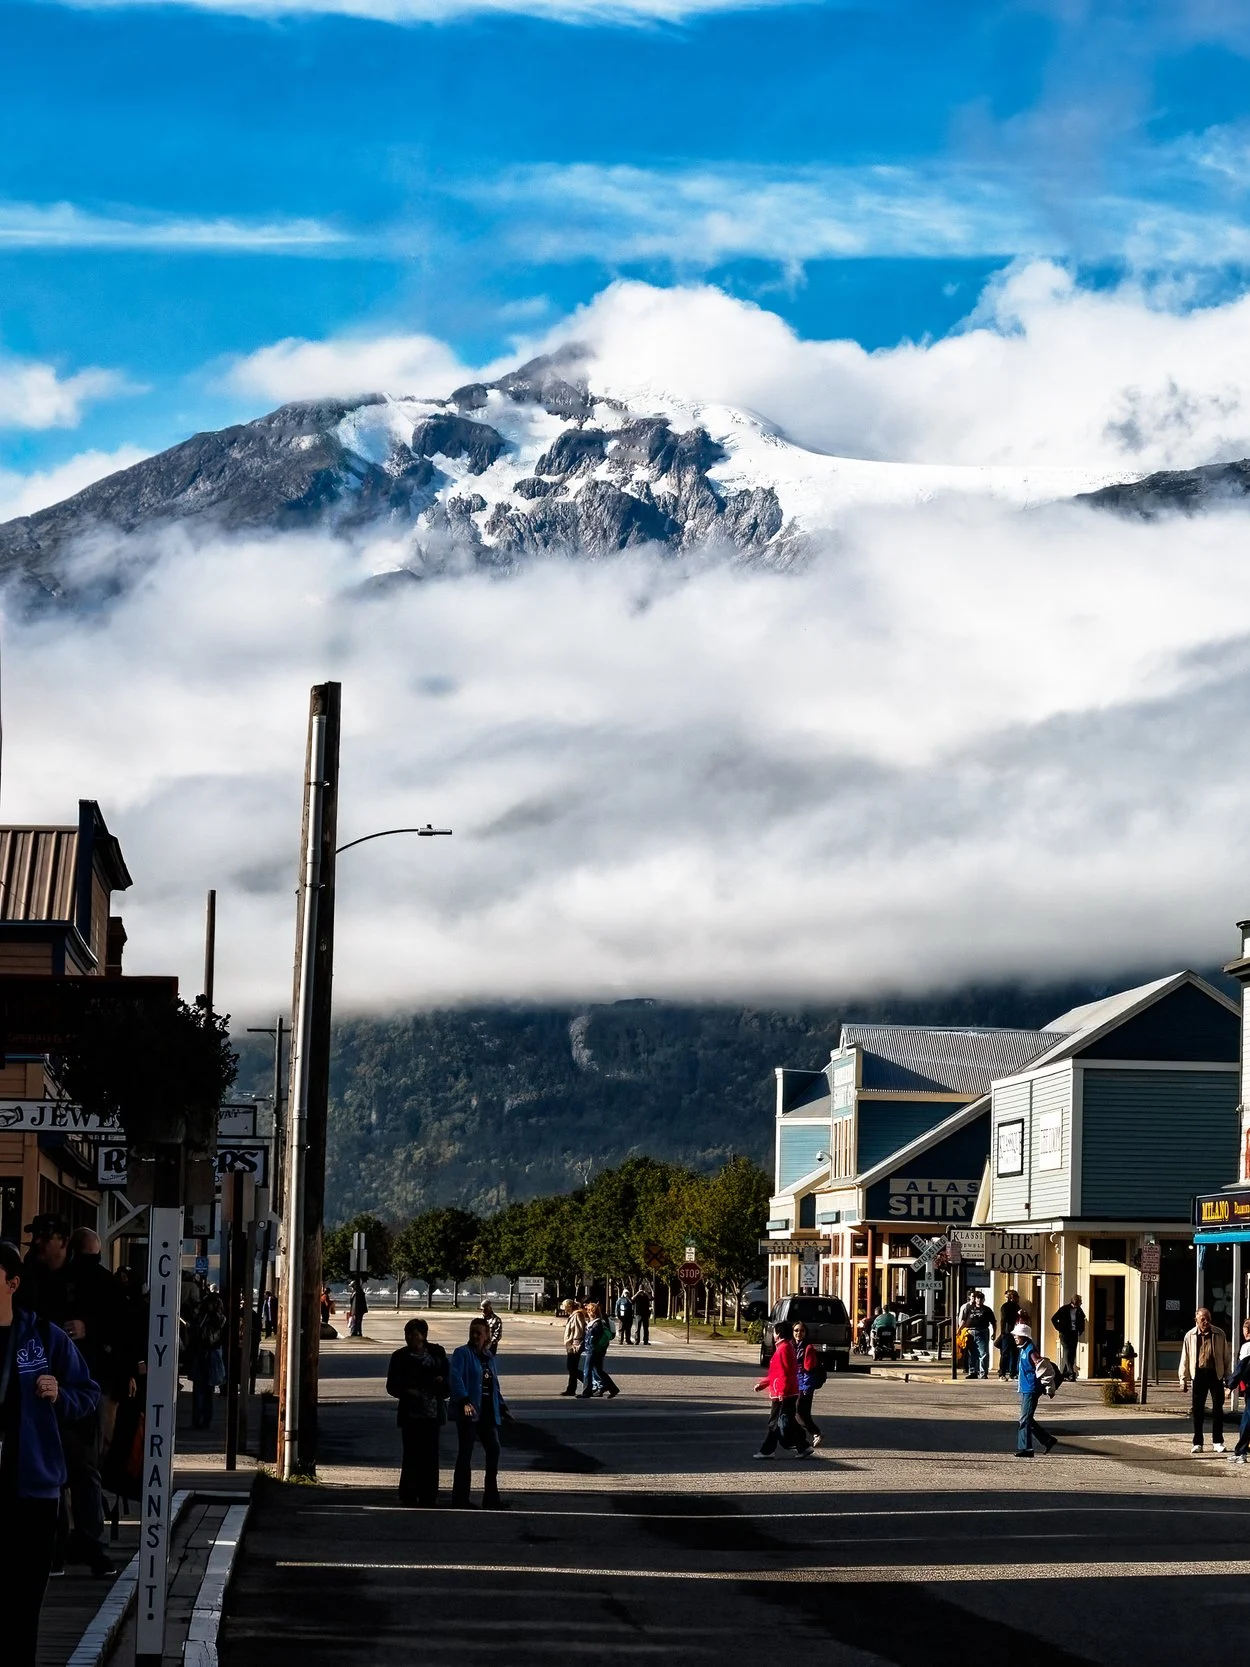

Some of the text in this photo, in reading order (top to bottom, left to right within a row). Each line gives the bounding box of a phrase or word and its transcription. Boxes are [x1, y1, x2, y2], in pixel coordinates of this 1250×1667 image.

[906, 1180, 978, 1193] ALAS
[1201, 1200, 1230, 1221] MILANO
[953, 1231, 984, 1241] KLASSI
[998, 1233, 1033, 1250] THE
[913, 1238, 946, 1269] CROSSING
[990, 1253, 1040, 1271] LOOM
[679, 1268, 700, 1279] STOP
